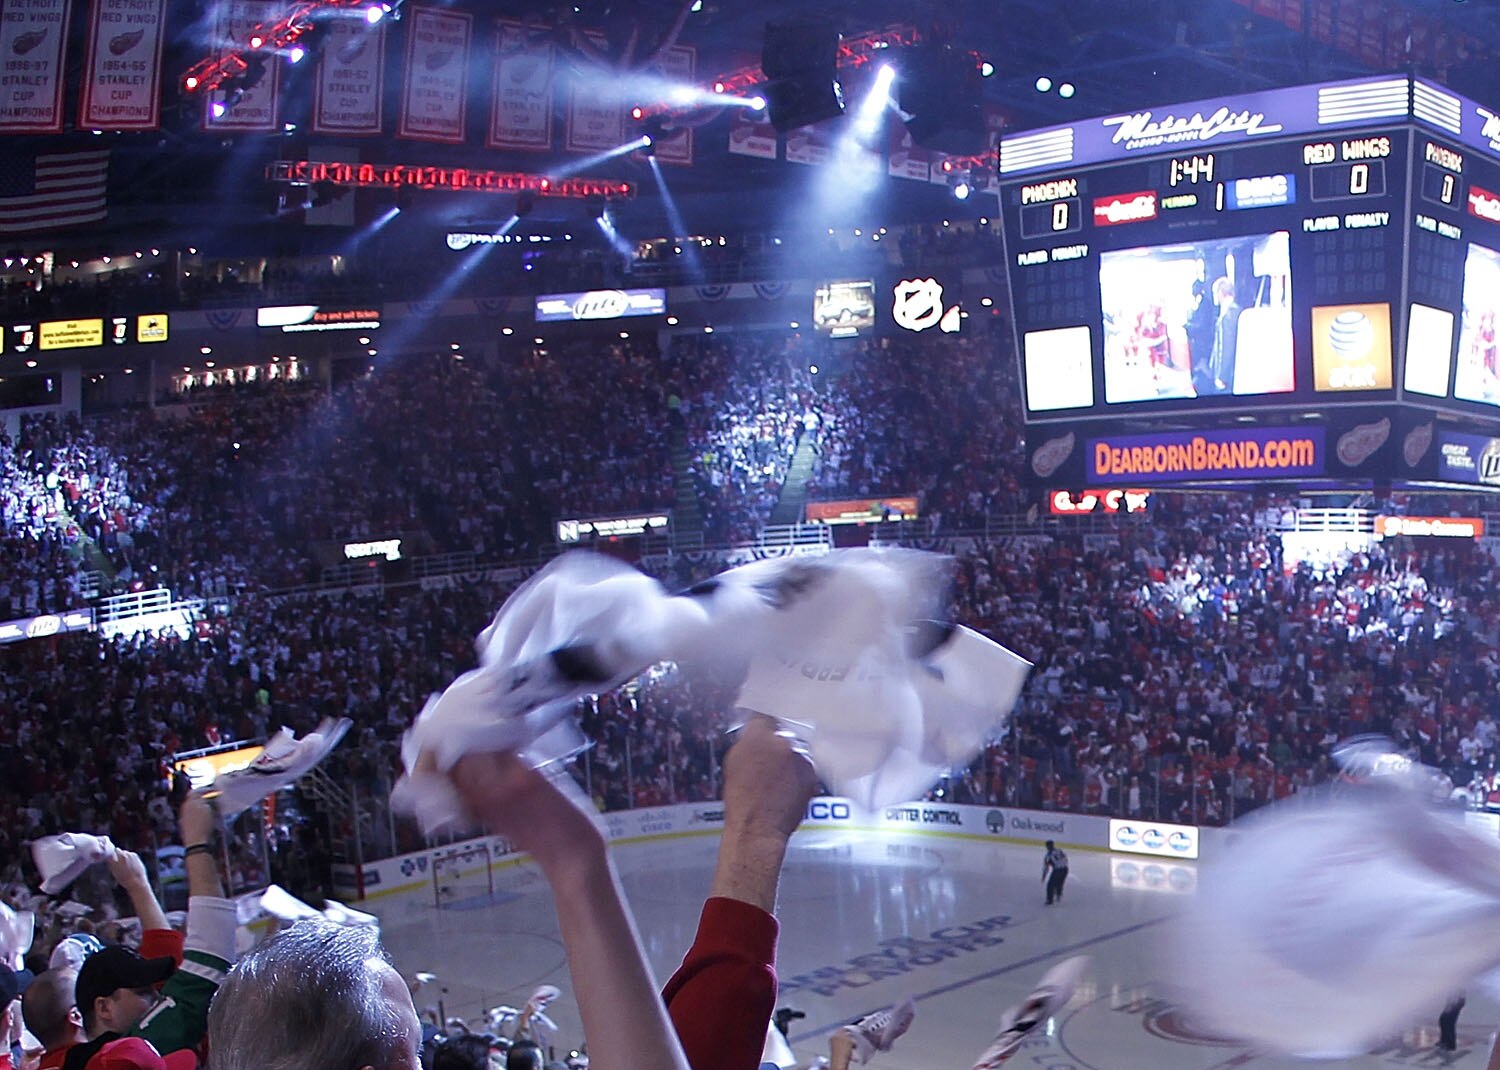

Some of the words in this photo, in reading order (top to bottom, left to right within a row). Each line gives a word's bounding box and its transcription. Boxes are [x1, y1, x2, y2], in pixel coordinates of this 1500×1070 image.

[2, 76, 48, 86] STANLEY
[99, 75, 145, 85] STANLEY
[13, 91, 35, 101] CUP
[111, 90, 132, 100] CUP
[0, 107, 52, 117] HAMPIONS
[92, 105, 149, 116] CHAMPIONS
[1303, 143, 1335, 165] RED
[1341, 137, 1390, 160] WINGS
[1170, 154, 1214, 187] 1:44
[1350, 163, 1368, 194] 0
[1021, 179, 1078, 205] PHOENIX
[1052, 203, 1068, 231] 0
[1302, 215, 1340, 233] PLAYER
[1344, 211, 1390, 229] PENALTY
[1011, 817, 1064, 833] Oakwood
